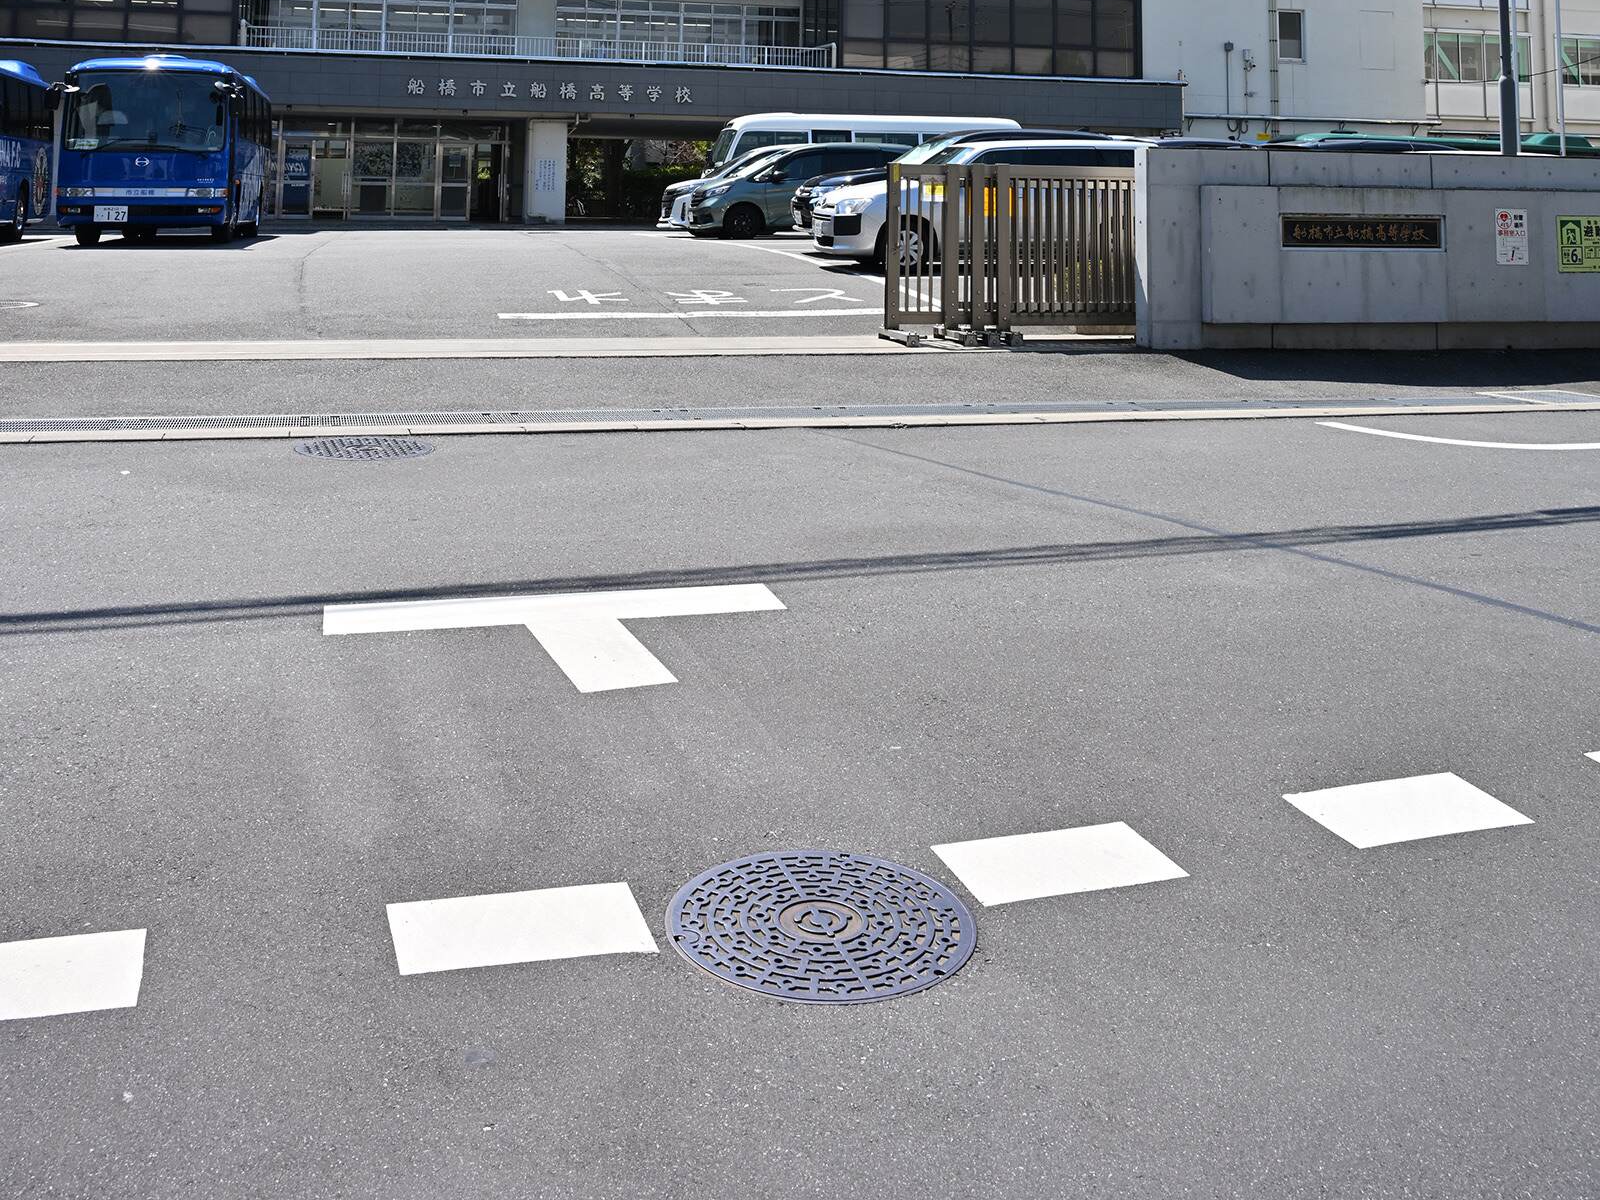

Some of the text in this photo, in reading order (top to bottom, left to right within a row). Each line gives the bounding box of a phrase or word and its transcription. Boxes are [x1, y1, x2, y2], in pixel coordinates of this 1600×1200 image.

[407, 78, 693, 104] 船橋市立船橋高等学校
[546, 287, 865, 305] とまれ
